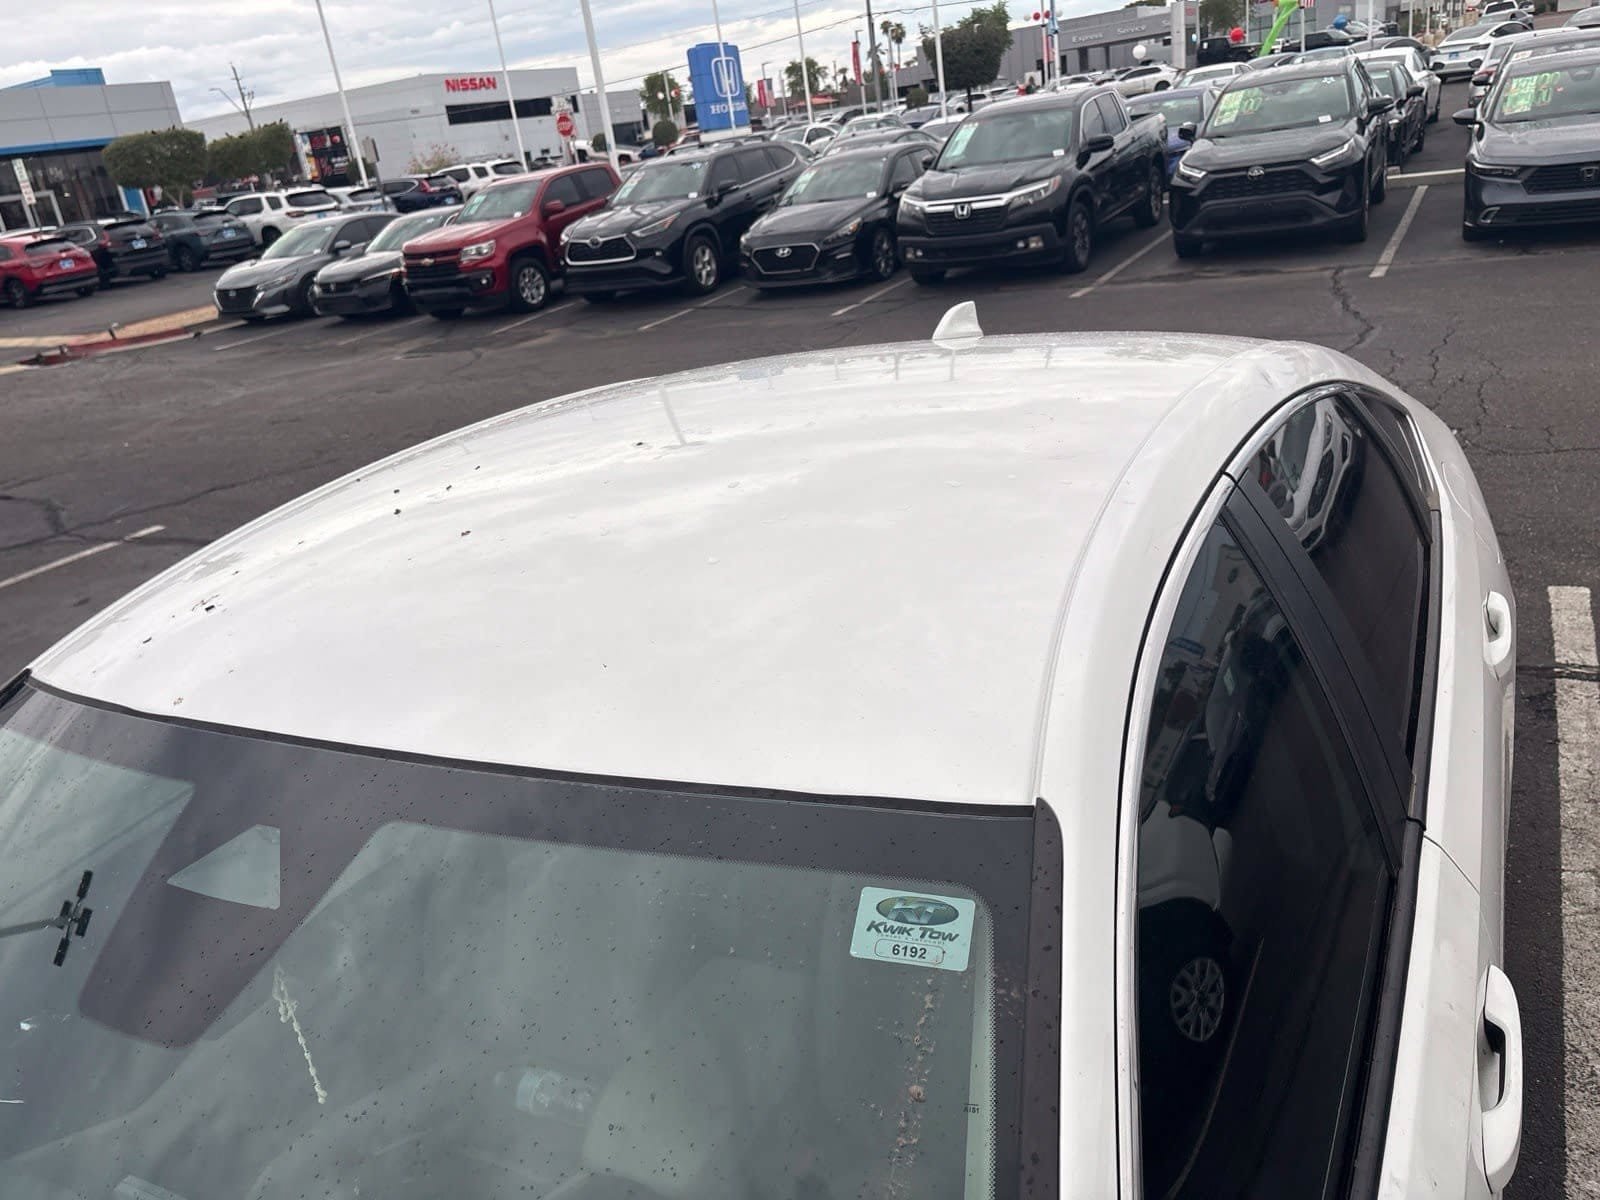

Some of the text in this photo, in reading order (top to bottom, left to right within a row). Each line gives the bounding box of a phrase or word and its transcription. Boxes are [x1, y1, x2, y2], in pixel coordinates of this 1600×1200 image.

[1071, 25, 1147, 43] Express Service
[445, 76, 497, 92] NISSAN
[892, 944, 927, 960] 6192
